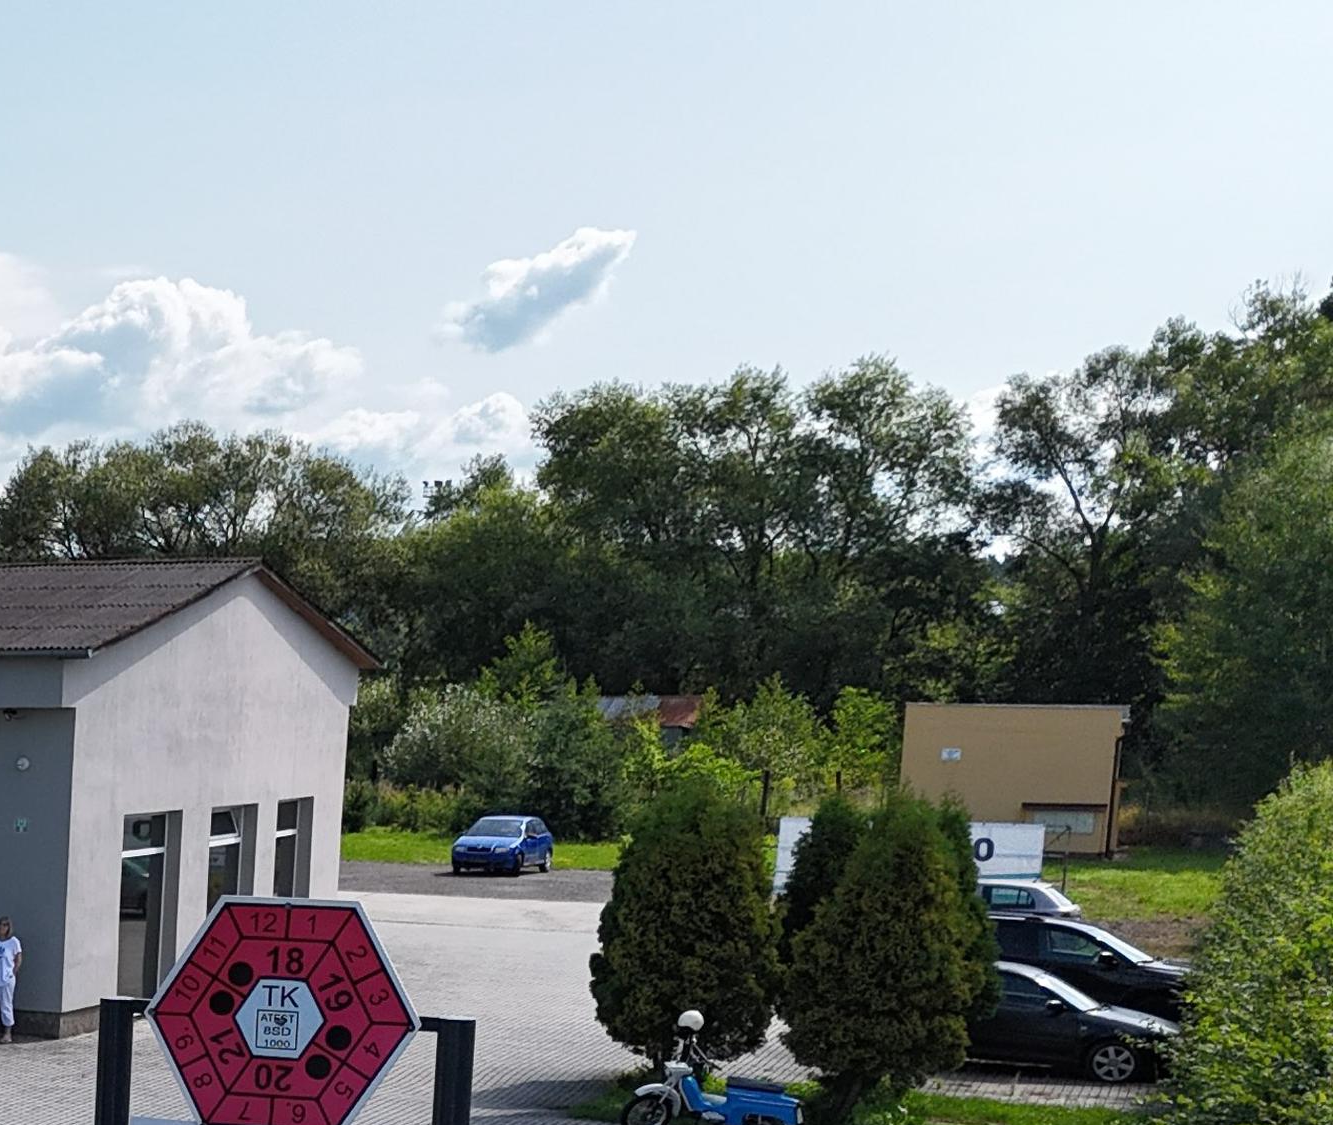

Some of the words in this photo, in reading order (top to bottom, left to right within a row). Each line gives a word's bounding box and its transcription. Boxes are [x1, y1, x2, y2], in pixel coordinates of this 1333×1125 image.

[250, 912, 277, 932] 12
[308, 915, 317, 934] 1
[203, 935, 227, 960] 11
[346, 945, 368, 963] 2
[267, 946, 304, 975] 18
[175, 975, 200, 1001] 10
[262, 985, 299, 1008] TK
[319, 973, 353, 1012] 19
[369, 989, 389, 1006] 3
[260, 1013, 295, 1024] ATEST
[210, 1028, 246, 1065] 21
[265, 1039, 290, 1049] 1000
[363, 1041, 381, 1059] 4
[193, 1073, 213, 1089] 8
[255, 1063, 294, 1092] 20
[334, 1081, 354, 1100] 5
[237, 1101, 252, 1120] 7
